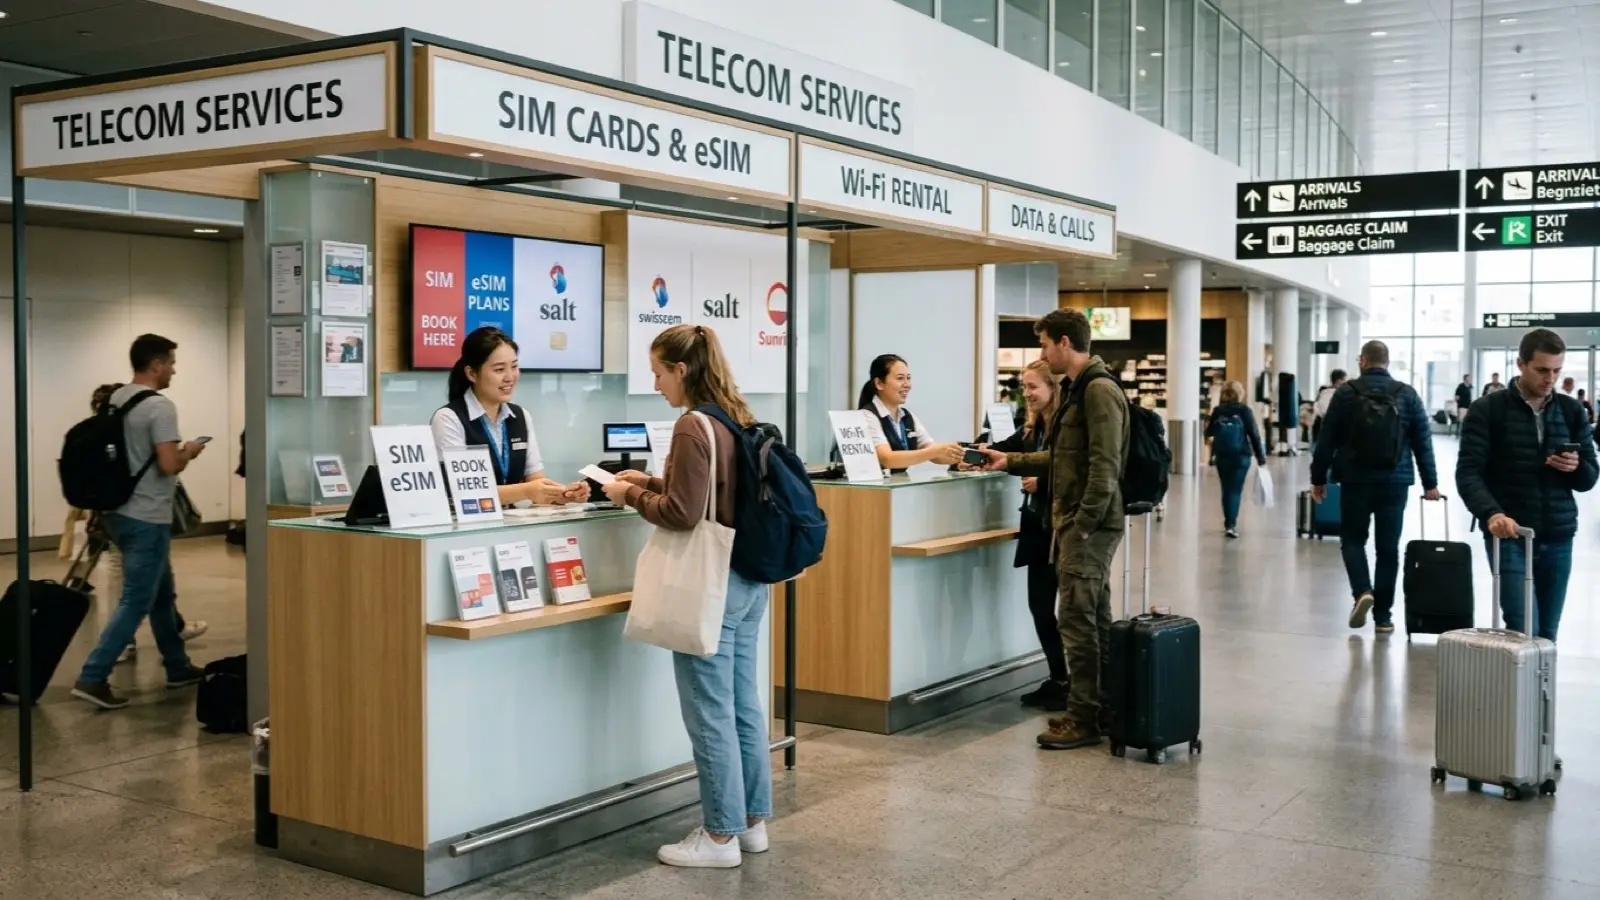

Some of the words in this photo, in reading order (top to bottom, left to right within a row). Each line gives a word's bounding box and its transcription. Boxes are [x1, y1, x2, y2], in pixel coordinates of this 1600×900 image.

[657, 30, 791, 106] TELECOM
[800, 74, 902, 136] SERVICES
[52, 100, 185, 150] TELECOM
[196, 79, 344, 134] SERVICES
[498, 90, 556, 137] SIM
[566, 106, 661, 157] CARDS
[669, 128, 688, 163] &
[695, 136, 751, 175] eSIM
[841, 165, 886, 201] Wi-Fi
[891, 177, 953, 215] RENTAL
[1298, 181, 1362, 196] ARRIVALS
[1011, 204, 1045, 233] DATA
[1047, 212, 1057, 235] &
[1059, 215, 1095, 242] CALLS
[1298, 223, 1362, 238] BAGGAGE
[1364, 221, 1409, 235] CLAIM
[1536, 214, 1568, 228] EXIT
[1536, 229, 1564, 244] Exit
[1298, 240, 1355, 255] Baggage
[1357, 237, 1396, 251] Claim
[425, 270, 454, 288] SIM
[471, 274, 506, 292] eSIM
[468, 295, 510, 312] PLANS
[539, 298, 577, 321] salt
[703, 292, 740, 319] salt
[421, 314, 457, 330] BOOK
[423, 333, 456, 347] HERE
[389, 444, 425, 464] SIM
[451, 459, 489, 473] BOOK
[390, 471, 437, 492] eSIM
[457, 476, 489, 491] HERE
